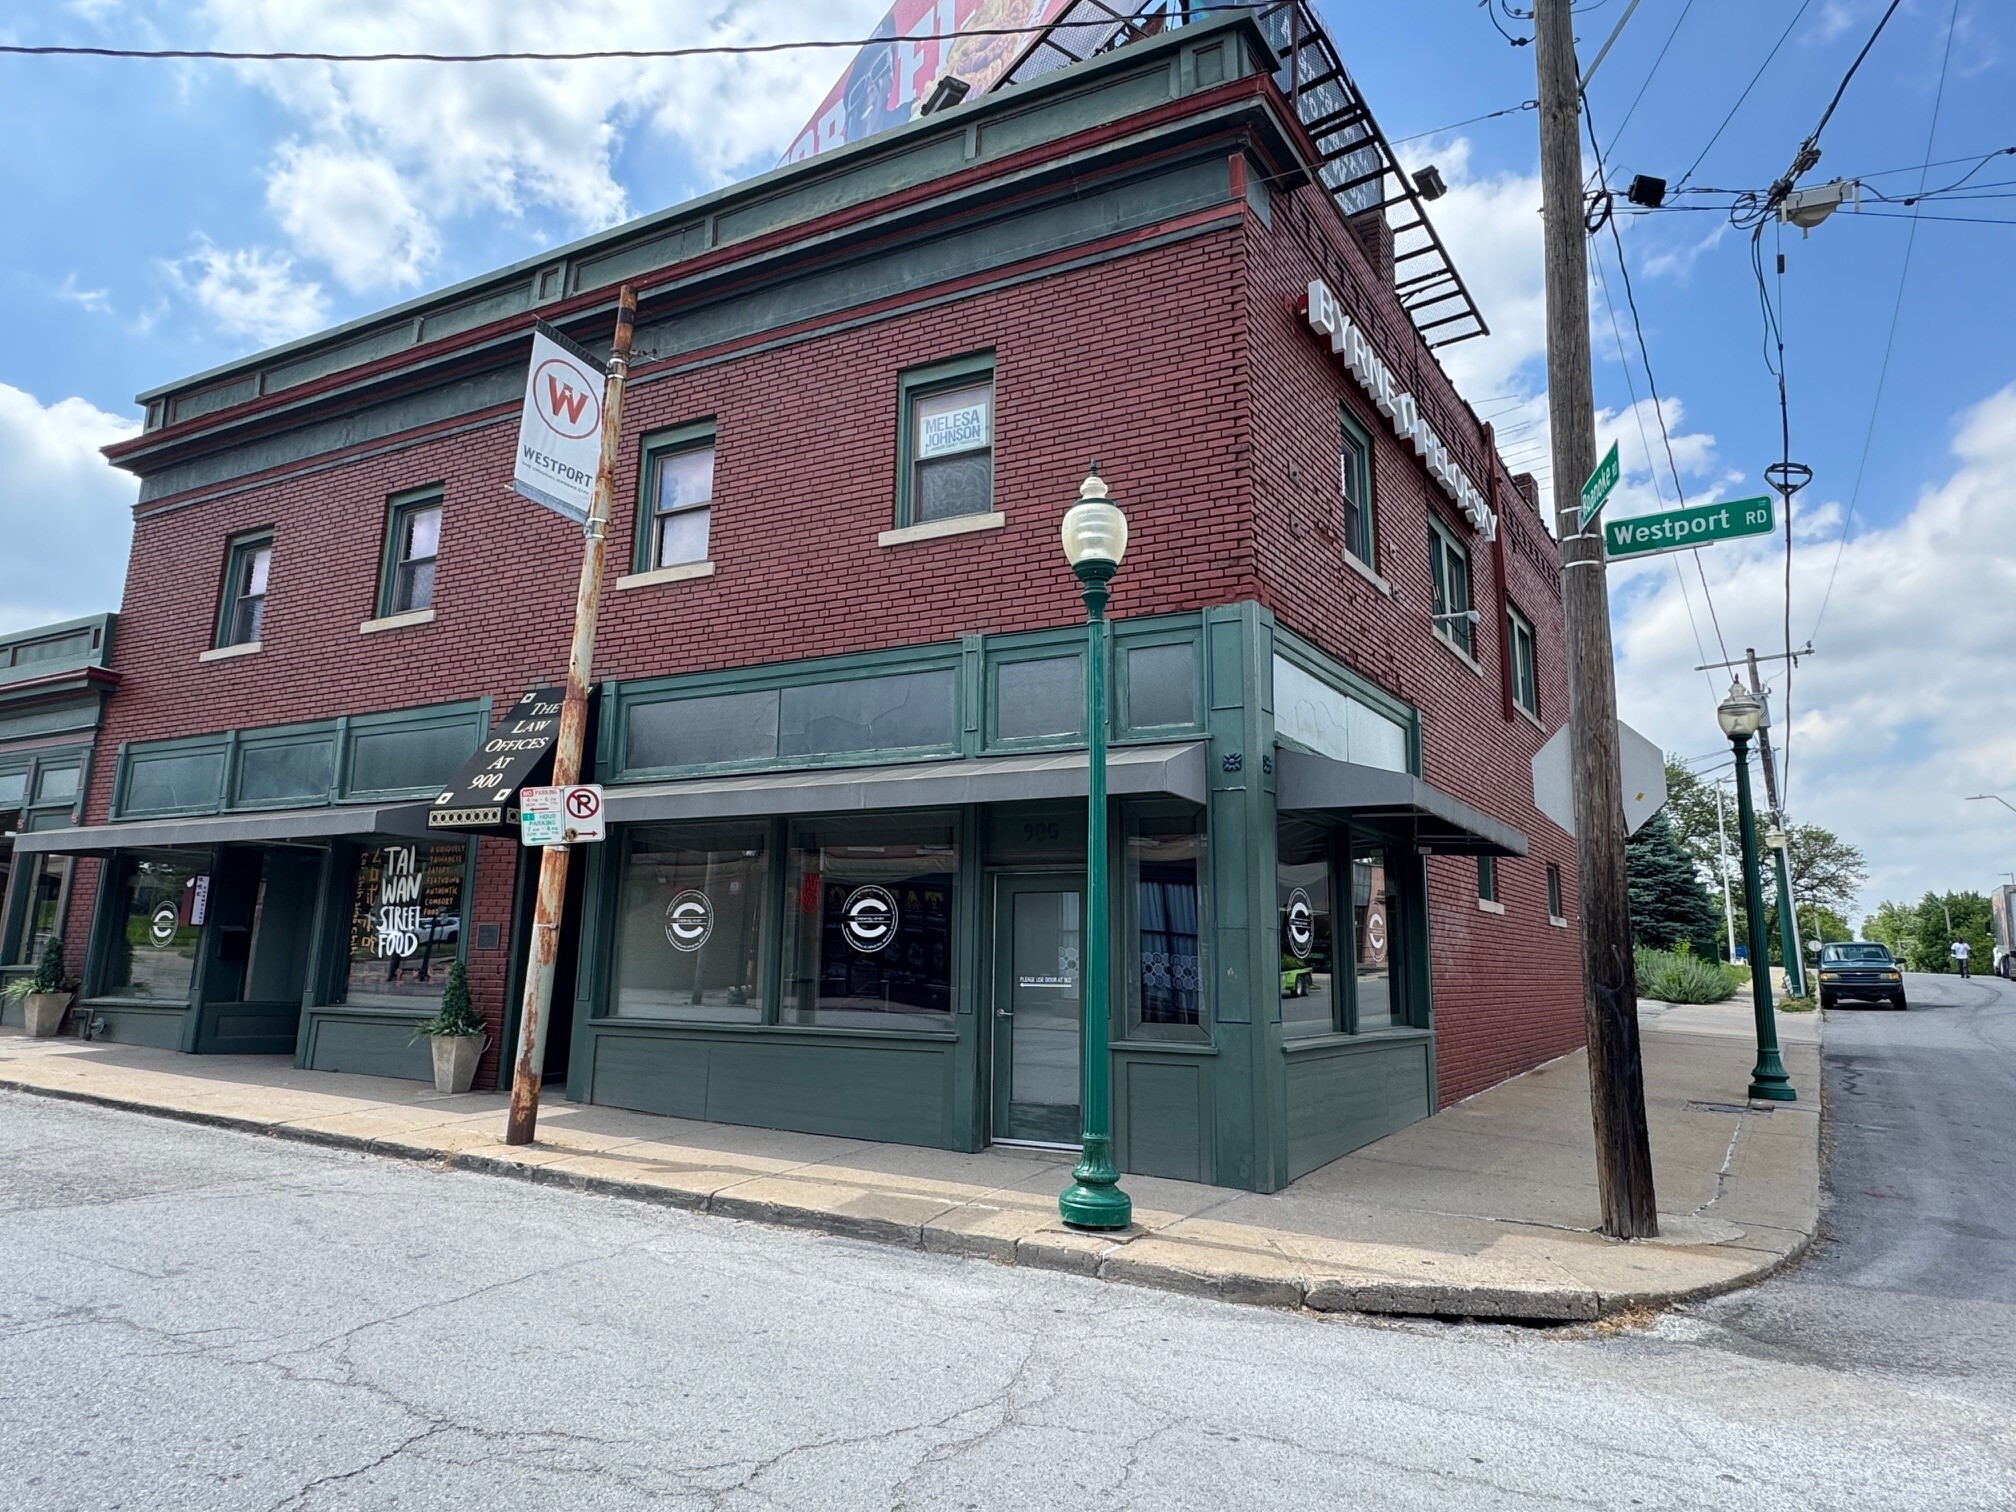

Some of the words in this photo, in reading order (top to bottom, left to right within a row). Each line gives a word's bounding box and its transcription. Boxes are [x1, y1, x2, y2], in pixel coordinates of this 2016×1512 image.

[1308, 278, 1397, 417] BYRNE
[547, 373, 589, 425] W
[926, 409, 980, 435] MELESA
[926, 425, 980, 447] JOHNSON
[523, 444, 593, 487] WESTPORT
[1582, 466, 1611, 518] Roanoke
[1614, 509, 1730, 545] Westport
[1745, 509, 1767, 525] RD
[467, 773, 503, 790] 900
[1023, 822, 1059, 842] 900
[384, 845, 417, 876] TAI
[382, 873, 422, 905] WAN
[425, 886, 458, 895] AUTHENTIC
[427, 876, 460, 885] FEATURING
[423, 908, 440, 916] FOOD
[424, 897, 454, 906] COMFORT
[376, 906, 421, 932] STREET
[378, 931, 419, 958] FOOD
